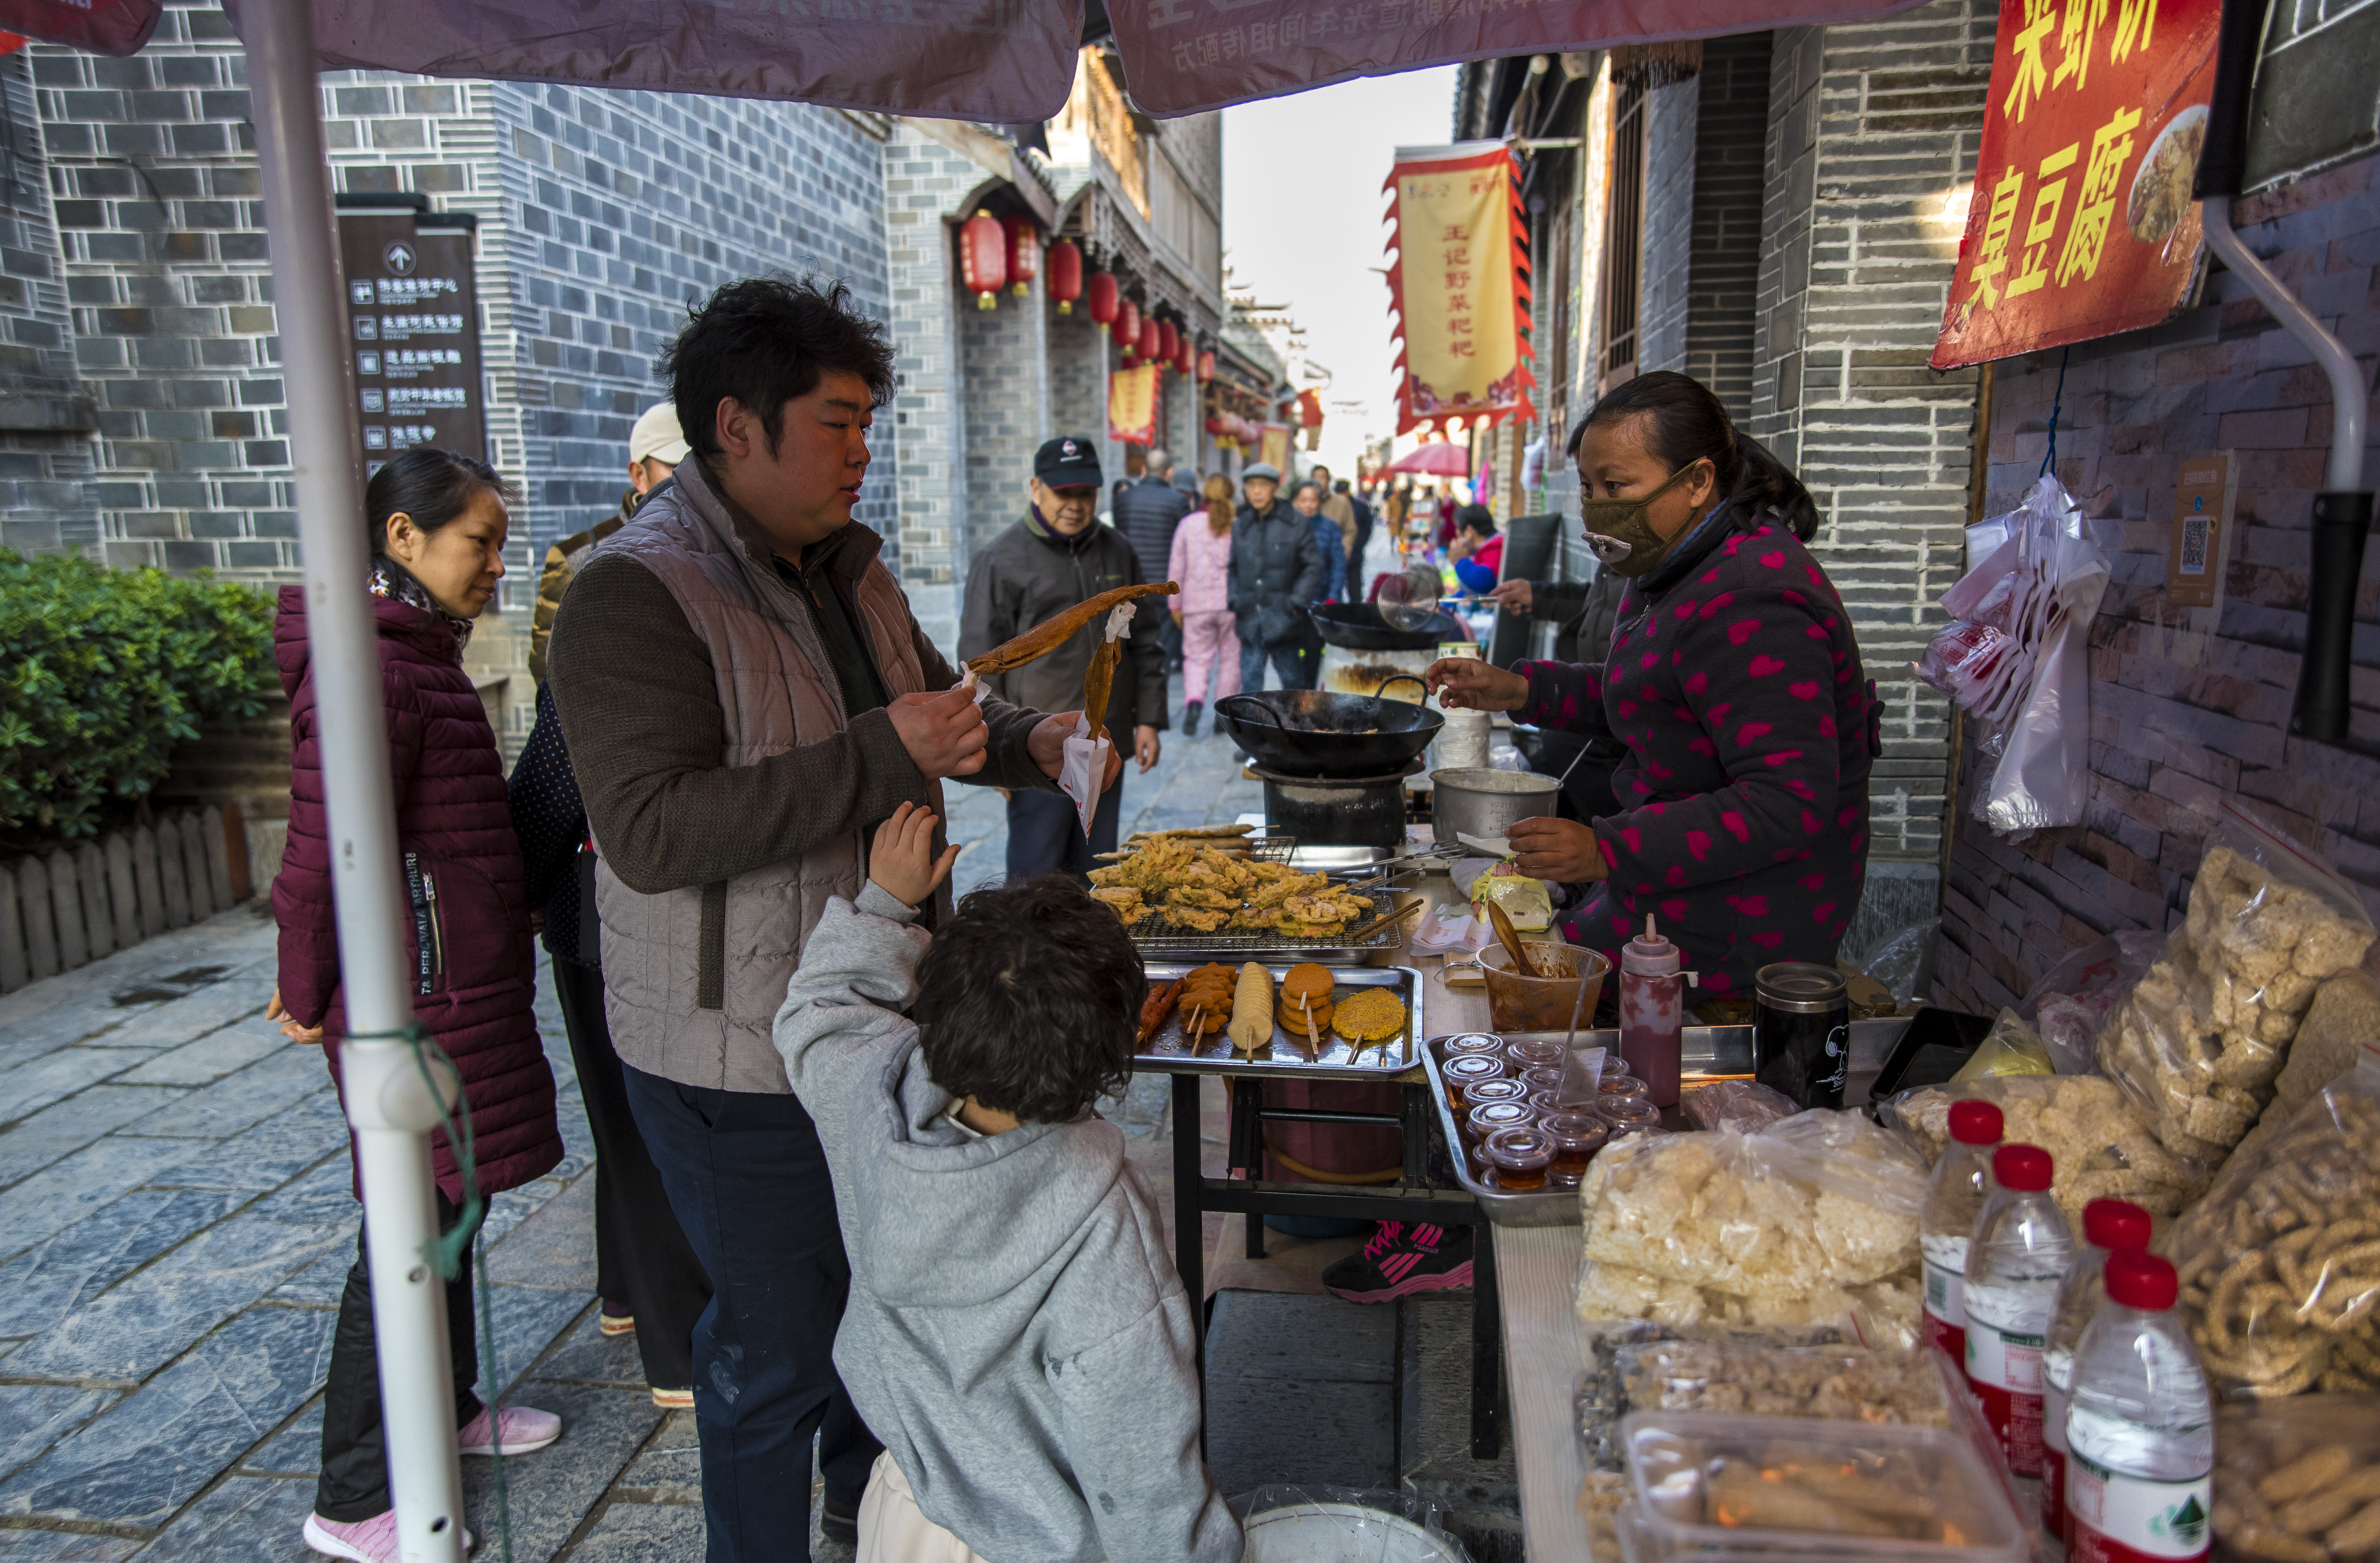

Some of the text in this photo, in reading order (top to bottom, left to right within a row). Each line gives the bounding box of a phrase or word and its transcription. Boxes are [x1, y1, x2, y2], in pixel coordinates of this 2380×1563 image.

[1442, 223, 1475, 359] 王记野菜粑粑
[1961, 105, 2142, 320] 臭豆腐
